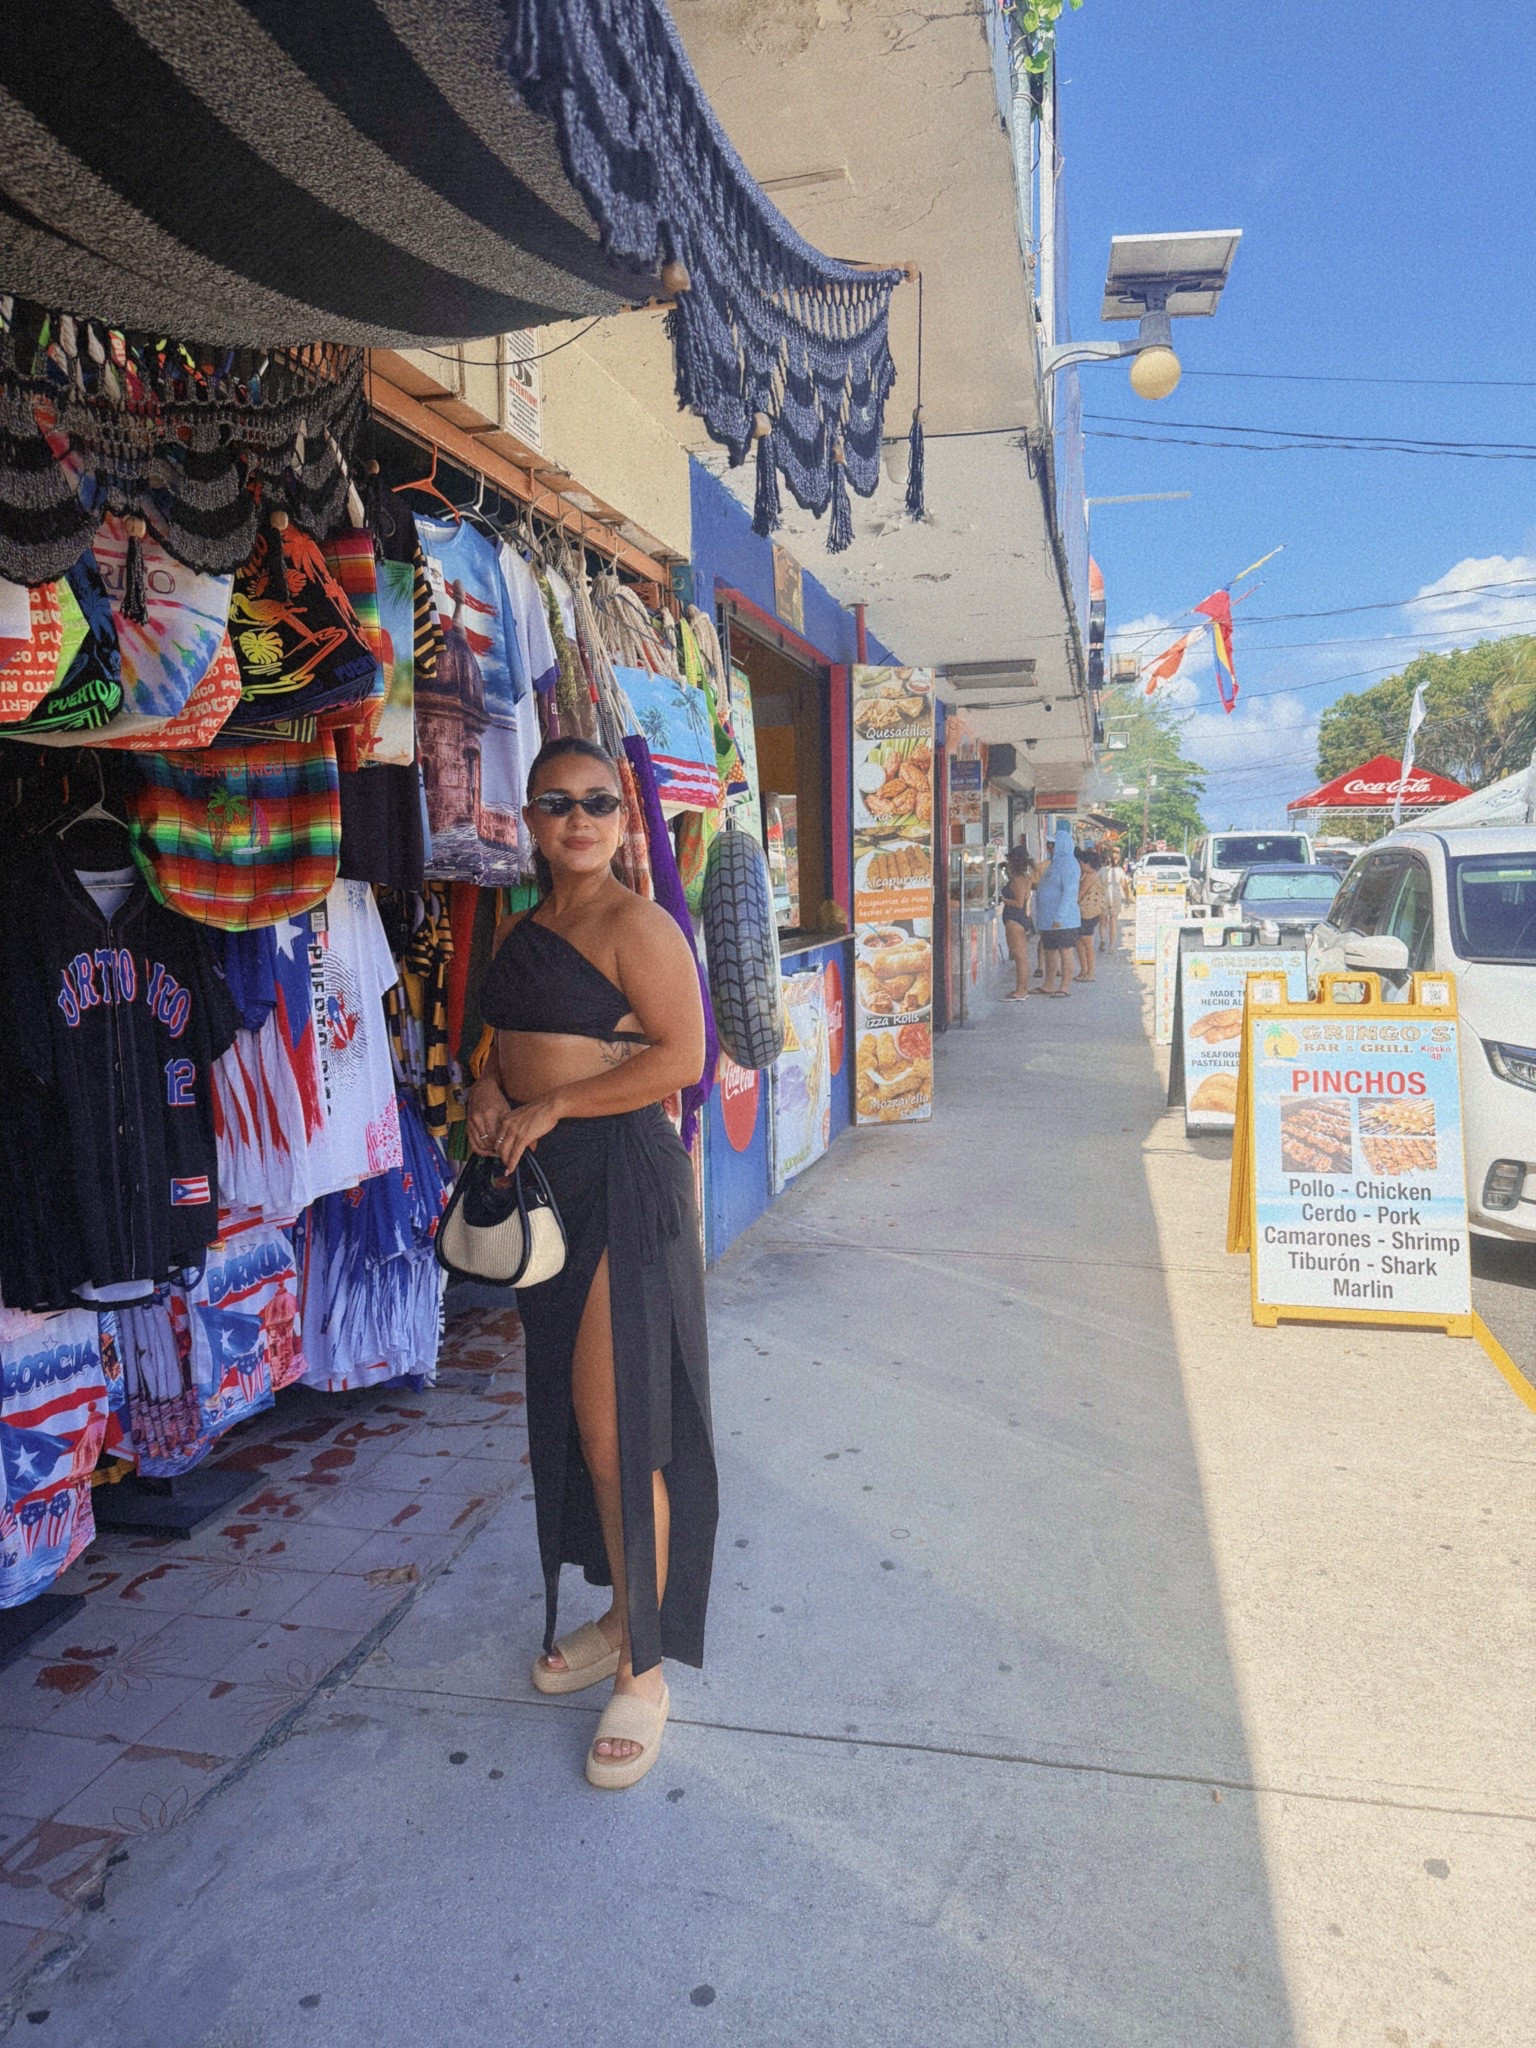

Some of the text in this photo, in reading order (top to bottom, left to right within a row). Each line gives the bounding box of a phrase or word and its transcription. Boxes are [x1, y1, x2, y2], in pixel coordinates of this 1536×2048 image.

[97, 561, 176, 595] RIO
[865, 723, 931, 740] Quesadillas
[182, 760, 284, 778] PUERTO RICO
[1343, 777, 1434, 795] Coca-Cola
[858, 810, 894, 824] Wings
[864, 873, 931, 888] Alcapurrias
[1201, 998, 1243, 1006] HECHO AL
[1210, 990, 1232, 998] MADE
[860, 1011, 920, 1029] Pizza Rolls
[1301, 1024, 1451, 1043] GRINGO'S
[1304, 1043, 1340, 1053] BAR
[1360, 1044, 1414, 1054] GRILL
[1420, 1044, 1452, 1053] Kiosko
[1430, 1053, 1442, 1061] 48
[164, 1057, 196, 1108] 12
[1291, 1069, 1427, 1095] PINCHOS
[869, 1092, 929, 1111] Mozzarella
[1288, 1178, 1335, 1198] Pollo
[1355, 1180, 1432, 1201] Chicken
[1301, 1203, 1357, 1223] Cerdo
[1377, 1206, 1421, 1225] Pork
[1264, 1225, 1371, 1248] Camarones
[1391, 1231, 1461, 1255] Shrimp
[1288, 1251, 1360, 1272] Tiburón
[1381, 1255, 1438, 1276] Shark
[1333, 1277, 1394, 1299] Marlin
